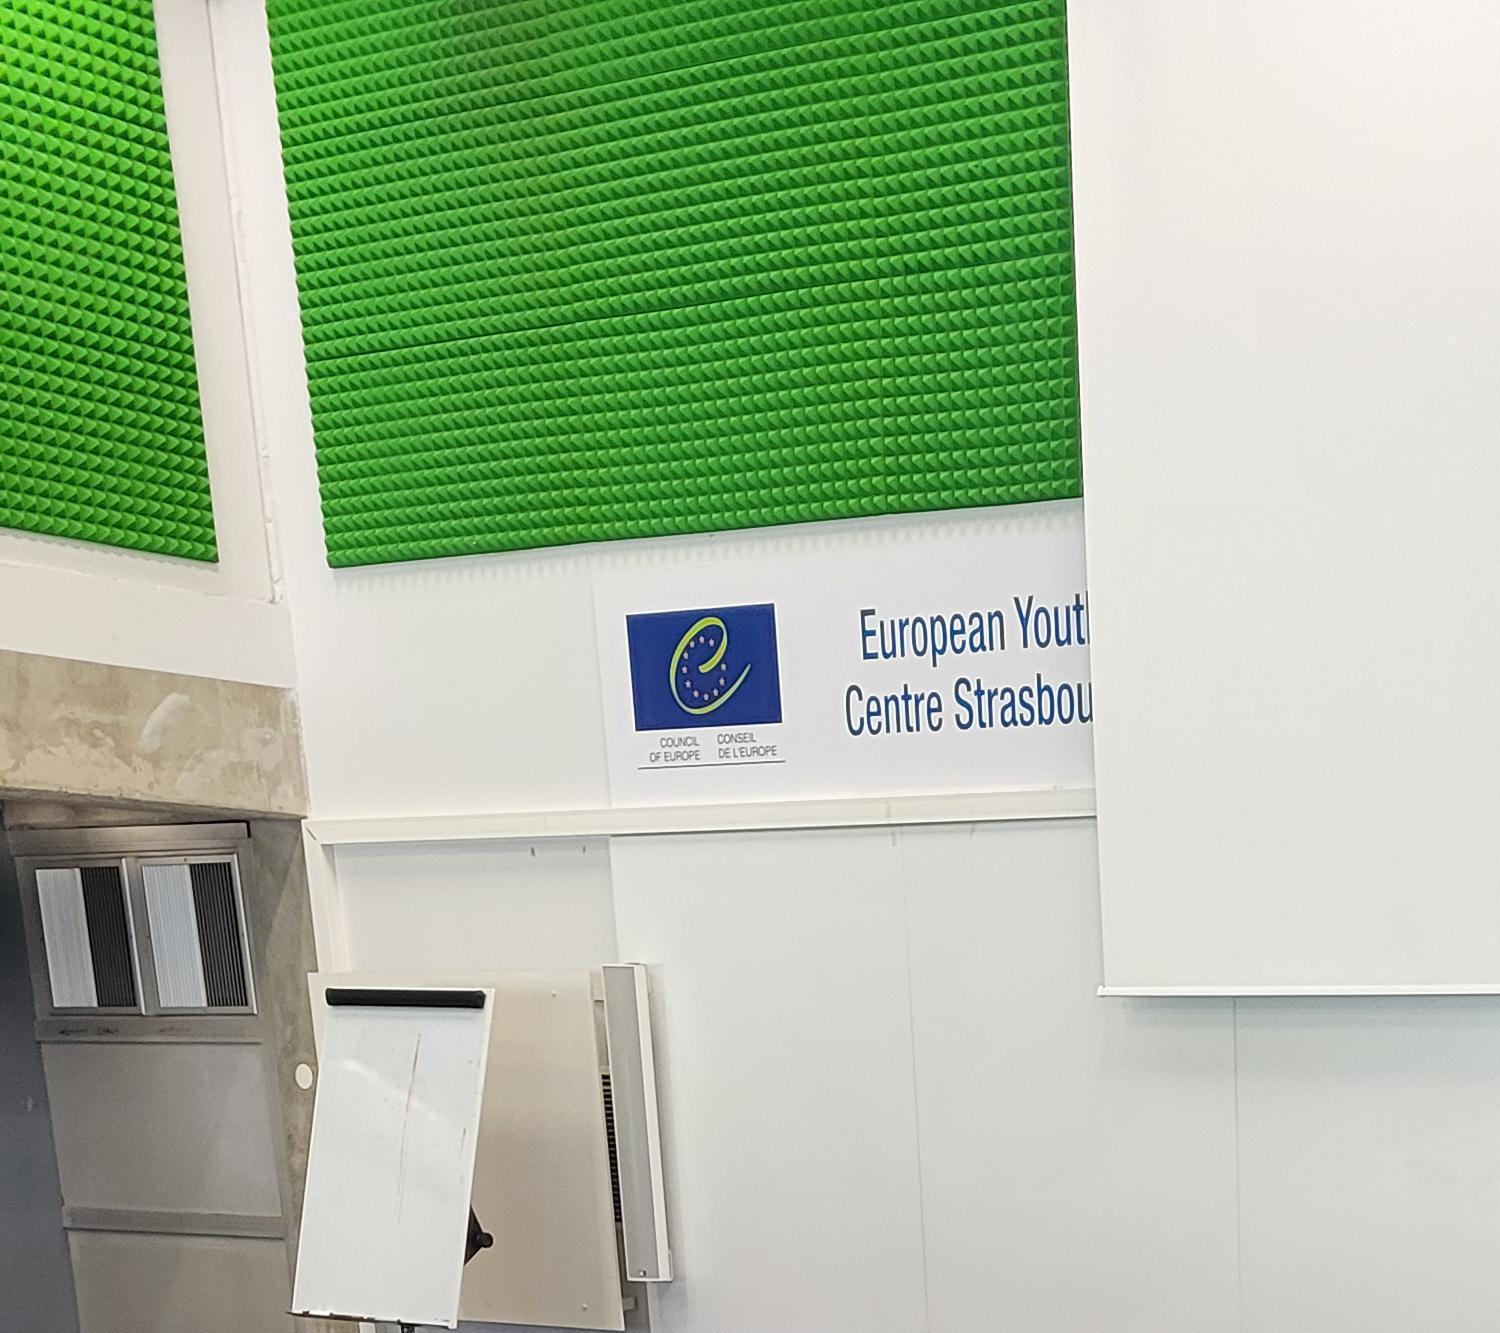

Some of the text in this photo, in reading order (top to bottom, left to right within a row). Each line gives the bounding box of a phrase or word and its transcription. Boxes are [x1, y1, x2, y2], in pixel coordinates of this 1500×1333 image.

[860, 590, 1090, 667] European Yout
[845, 672, 1094, 737] Centre Strasbou
[660, 736, 700, 748] COUNCIL
[717, 732, 757, 744] CONSEIL
[649, 749, 701, 763] OF EUROPE
[718, 745, 777, 759] DE L'EUROPE
